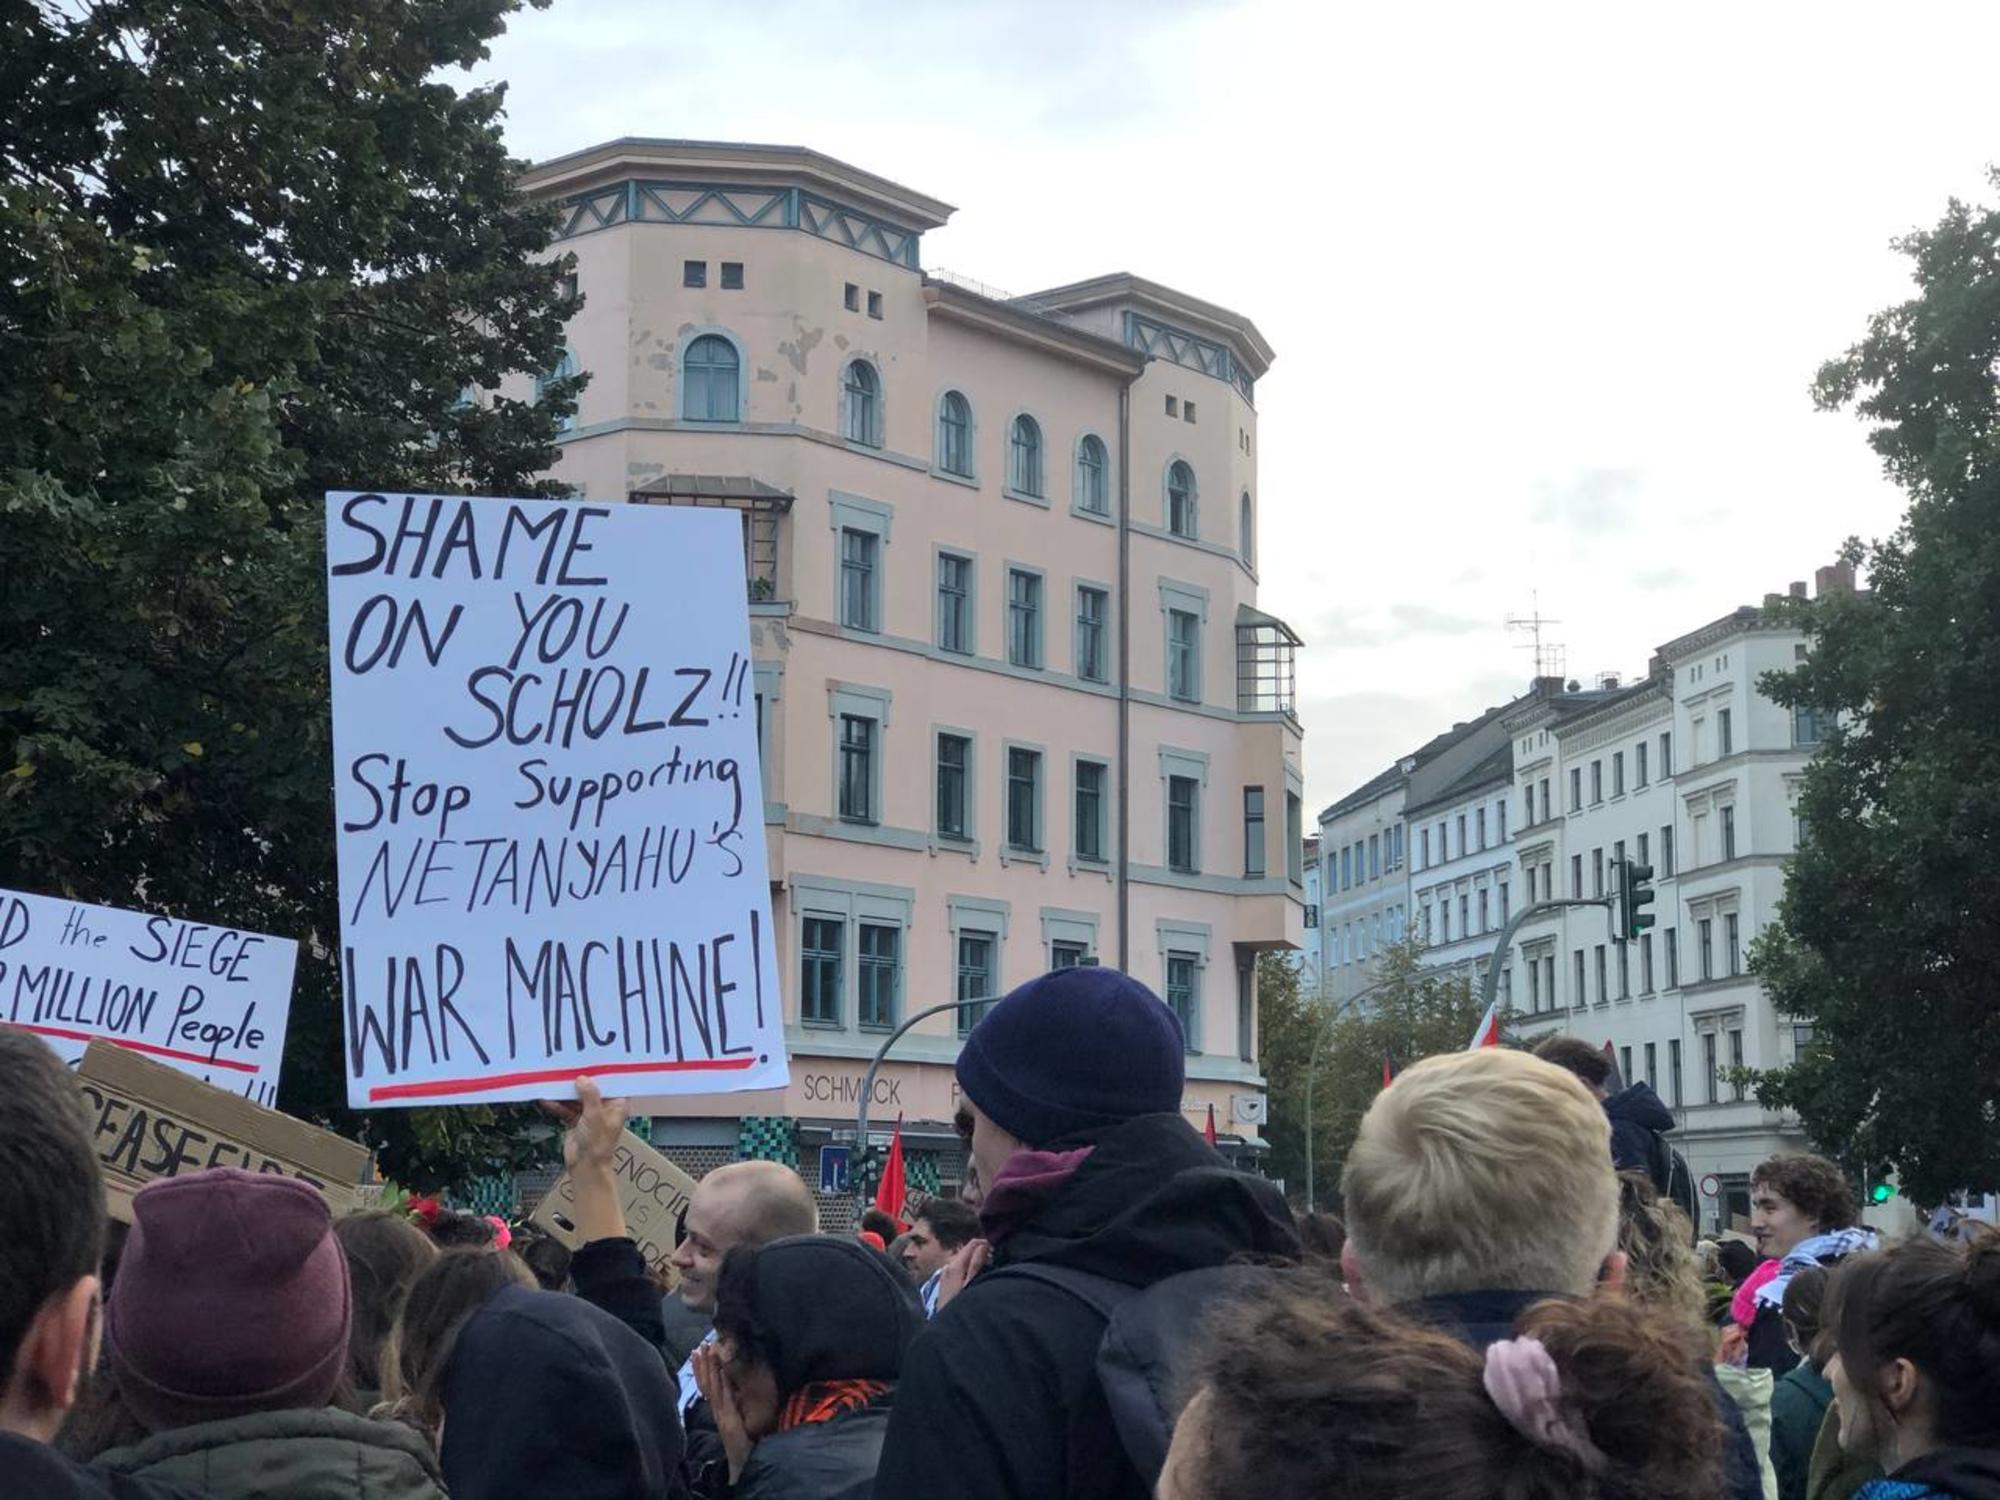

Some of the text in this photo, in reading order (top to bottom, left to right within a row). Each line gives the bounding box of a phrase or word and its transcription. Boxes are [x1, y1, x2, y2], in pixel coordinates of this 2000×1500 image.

[331, 493, 610, 586] SHAME
[345, 592, 630, 675] ON YOU
[444, 652, 748, 749] SCHOLZ!!
[344, 746, 743, 838] Stop Supporting
[60, 906, 108, 948] the
[129, 916, 265, 982] SIEGE
[10, 963, 158, 1035] MILLION
[166, 985, 265, 1065] People
[346, 910, 768, 1078] WAR MACHINE!
[626, 1197, 650, 1224] IS
